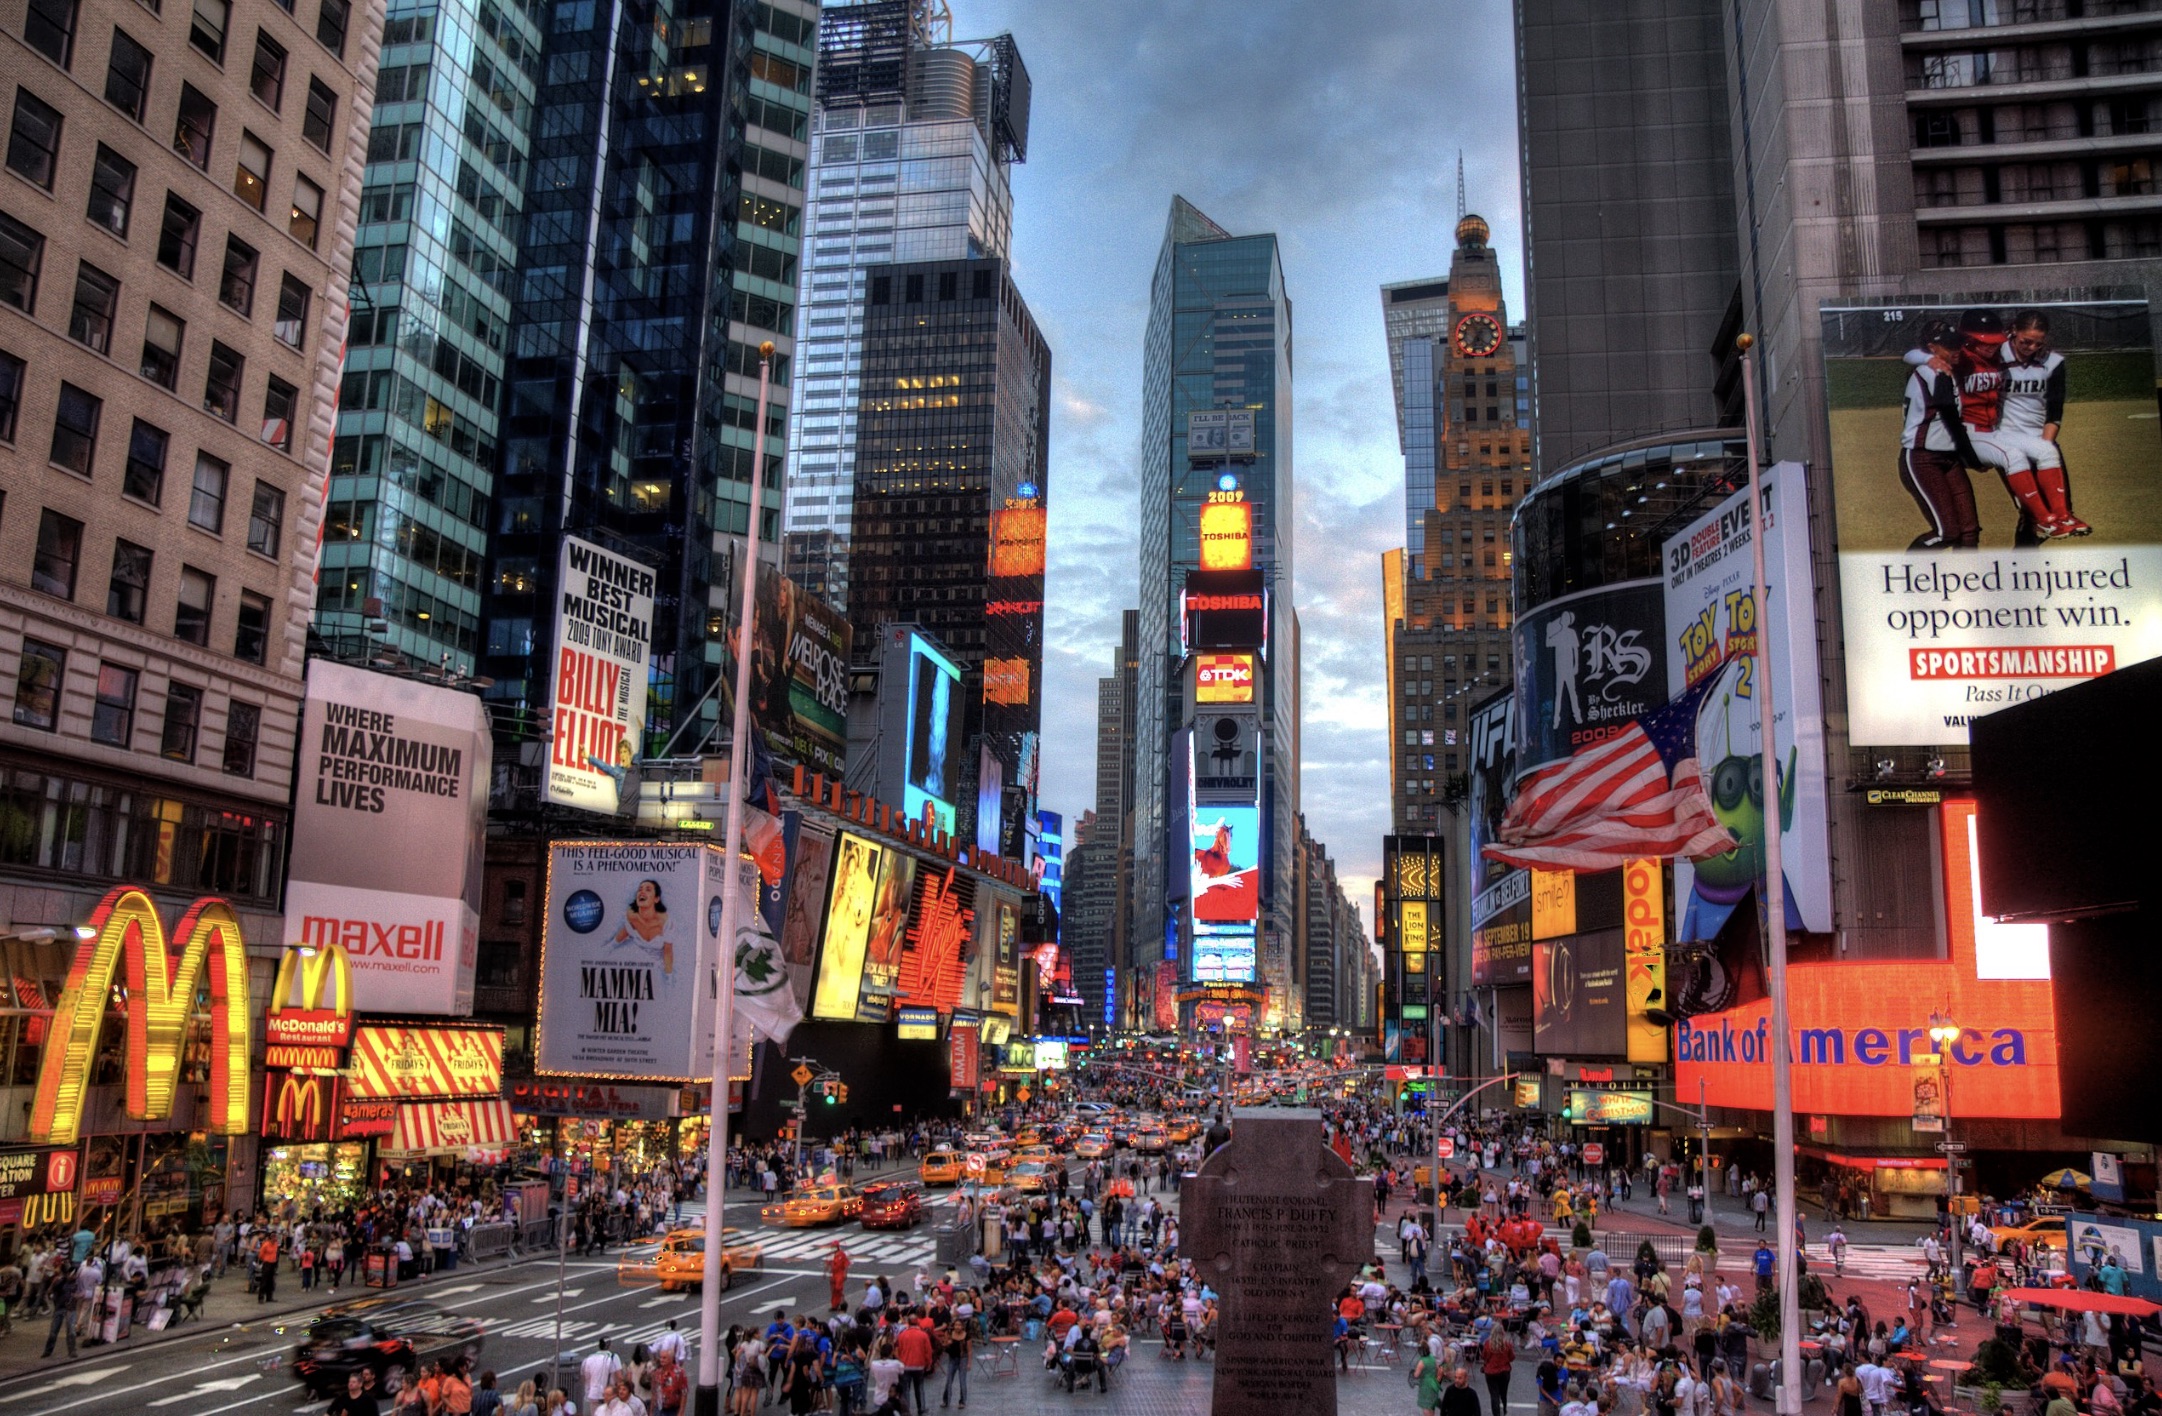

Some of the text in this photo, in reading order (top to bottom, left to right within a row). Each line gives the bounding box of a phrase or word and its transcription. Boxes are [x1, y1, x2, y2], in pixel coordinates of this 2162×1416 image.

[1884, 311, 1904, 321] 215
[2004, 380, 2048, 392] ENTRA
[1208, 491, 1244, 503] 2009
[1202, 532, 1249, 541] TOSHIBA
[1670, 483, 1773, 573] 3D DOUBLE FEATURE EVET
[569, 542, 654, 599] WINNER
[1671, 569, 1685, 589] ONLY
[1686, 568, 1693, 581] IN
[1694, 549, 1722, 575] THEATRES
[1723, 545, 1729, 557] 2
[1722, 570, 1740, 588] PIXAR
[1882, 557, 2133, 601] Helped injured
[587, 577, 634, 613] BEST
[1187, 595, 1262, 610] TOSHIBA
[564, 592, 649, 643] MUSICAL
[1887, 596, 2131, 638] opponent win.
[567, 619, 642, 664] 2009 TONY AWARD
[1679, 600, 1718, 666] TOY
[789, 631, 845, 687] MELROSE
[1582, 623, 1651, 703] RS
[1916, 649, 2109, 677] SPORTSMANSHIP
[1210, 669, 1248, 681] TDK
[1687, 652, 1718, 686] STORY
[1736, 653, 1752, 700] 2
[557, 646, 620, 718] BILLY
[618, 667, 631, 722] THE MUSICAL
[816, 674, 847, 717] PLACE
[1966, 685, 2021, 702] Pass It
[326, 701, 394, 734] WHERE
[1587, 701, 1645, 722] Sheckler
[321, 724, 462, 777] MAXIMUM
[552, 707, 627, 776] ELLIOT
[319, 755, 459, 798] PERFORMANCE
[1198, 777, 1254, 788] CHEVROLET
[316, 778, 385, 814] LIVES
[556, 847, 698, 860] "THIS FEEL-GOOD MUSICAL
[573, 861, 681, 873] IS A PHENOMENON!"
[1472, 871, 1530, 926] FRANKLIN BELFORT
[1536, 879, 1570, 913] smile?
[1407, 911, 1421, 919] THE
[1627, 857, 1660, 982] Kodak
[1404, 920, 1424, 931] LION
[1484, 924, 1518, 946] SEPTEMBER
[1521, 922, 1530, 940] 19
[302, 916, 444, 961] maxell
[1405, 933, 1425, 946] KING
[350, 960, 440, 974] ww.maxell.com
[580, 967, 654, 1000] MAMMA
[269, 1018, 346, 1035] McDonald's
[593, 1001, 638, 1034] MIA!
[280, 1033, 331, 1043] Restaurant
[1678, 1017, 2026, 1066] Bank of merca
[391, 1059, 484, 1069] FRIDAY'S FRIDAY'S
[954, 1033, 966, 1085] JAMJAM
[514, 1083, 620, 1101] DIGITAL
[1570, 1082, 1653, 1090] MARQUIS
[1598, 1093, 1632, 1105] WHITE
[1586, 1103, 1648, 1121] CHRISTMAS
[0, 1168, 33, 1183] ATION
[1225, 1195, 1328, 1206] LIEUTENANT COLONEL
[1218, 1207, 1272, 1220] FRANCIS
[1290, 1209, 1337, 1221] DUFFY
[1232, 1239, 1320, 1249] CATHOLIC PRIEST
[1252, 1263, 1300, 1272] CHAPLAIN
[1244, 1289, 1263, 1297] OLD
[1243, 1313, 1262, 1322] LIFE
[1265, 1313, 1279, 1322] OF
[1282, 1314, 1320, 1323] SERVICE
[1228, 1332, 1323, 1342] GOD AND COUNTRY
[1259, 1358, 1305, 1366] AMERICAN
[1216, 1368, 1336, 1378] NEW YORK NATIONAL GUARD
